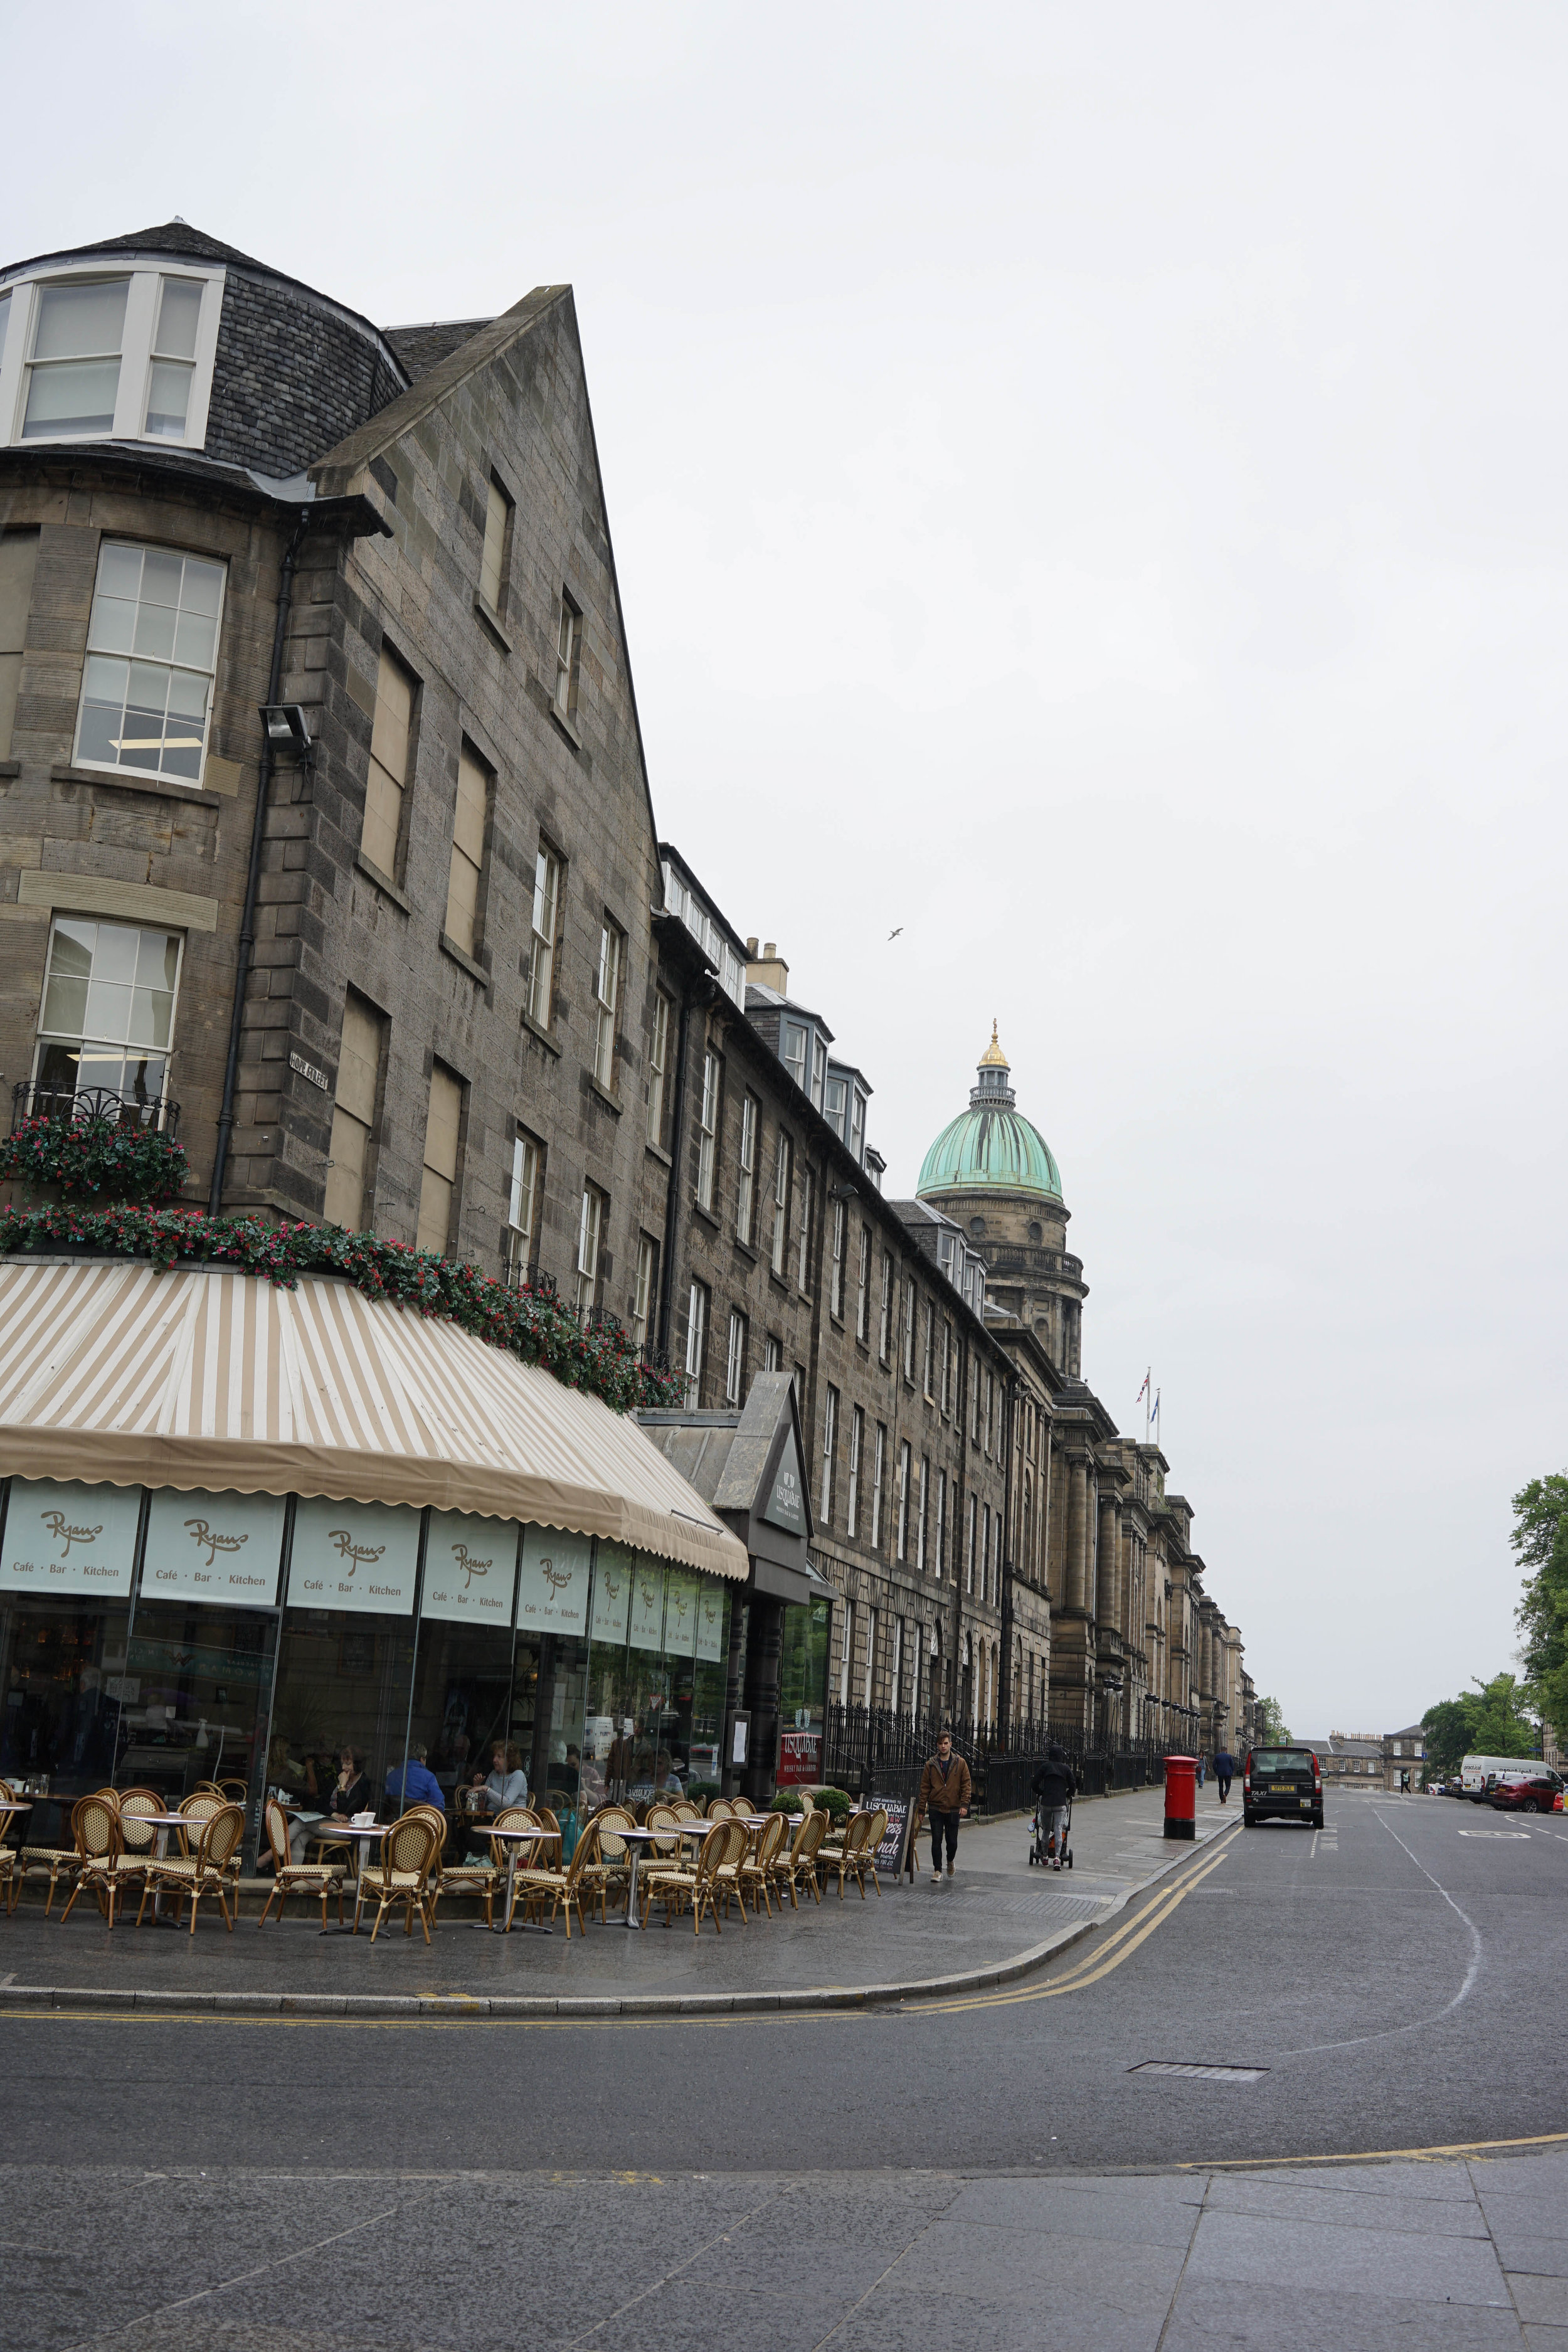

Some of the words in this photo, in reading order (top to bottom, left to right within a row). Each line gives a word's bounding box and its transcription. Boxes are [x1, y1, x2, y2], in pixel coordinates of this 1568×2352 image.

[291, 1052, 306, 1073] HOPE
[307, 1066, 327, 1088] STREET
[776, 1485, 800, 1508] USQUABAE
[41, 1511, 103, 1558] Ryans
[184, 1519, 249, 1566] Ryans
[328, 1530, 386, 1577] Ryans
[452, 1544, 493, 1589] Ryans
[13, 1561, 34, 1572] Café
[50, 1564, 66, 1574] Bar
[83, 1565, 119, 1577] Kitchen
[156, 1569, 177, 1580] Café
[194, 1572, 212, 1582] Bar
[229, 1574, 265, 1586] Kitchen
[540, 1558, 572, 1601] Ryans
[304, 1579, 323, 1590] Café
[338, 1582, 354, 1592] Bar
[369, 1585, 401, 1596] Kitchen
[433, 1591, 447, 1601] Café
[458, 1594, 469, 1604] Bar
[480, 1597, 503, 1608] Kitchen
[525, 1604, 536, 1613] Café
[544, 1606, 553, 1615] Bar
[561, 1608, 579, 1619] Kitchen
[785, 1732, 817, 1761] USQUABAE
[866, 1801, 906, 1813] USQUABAE
